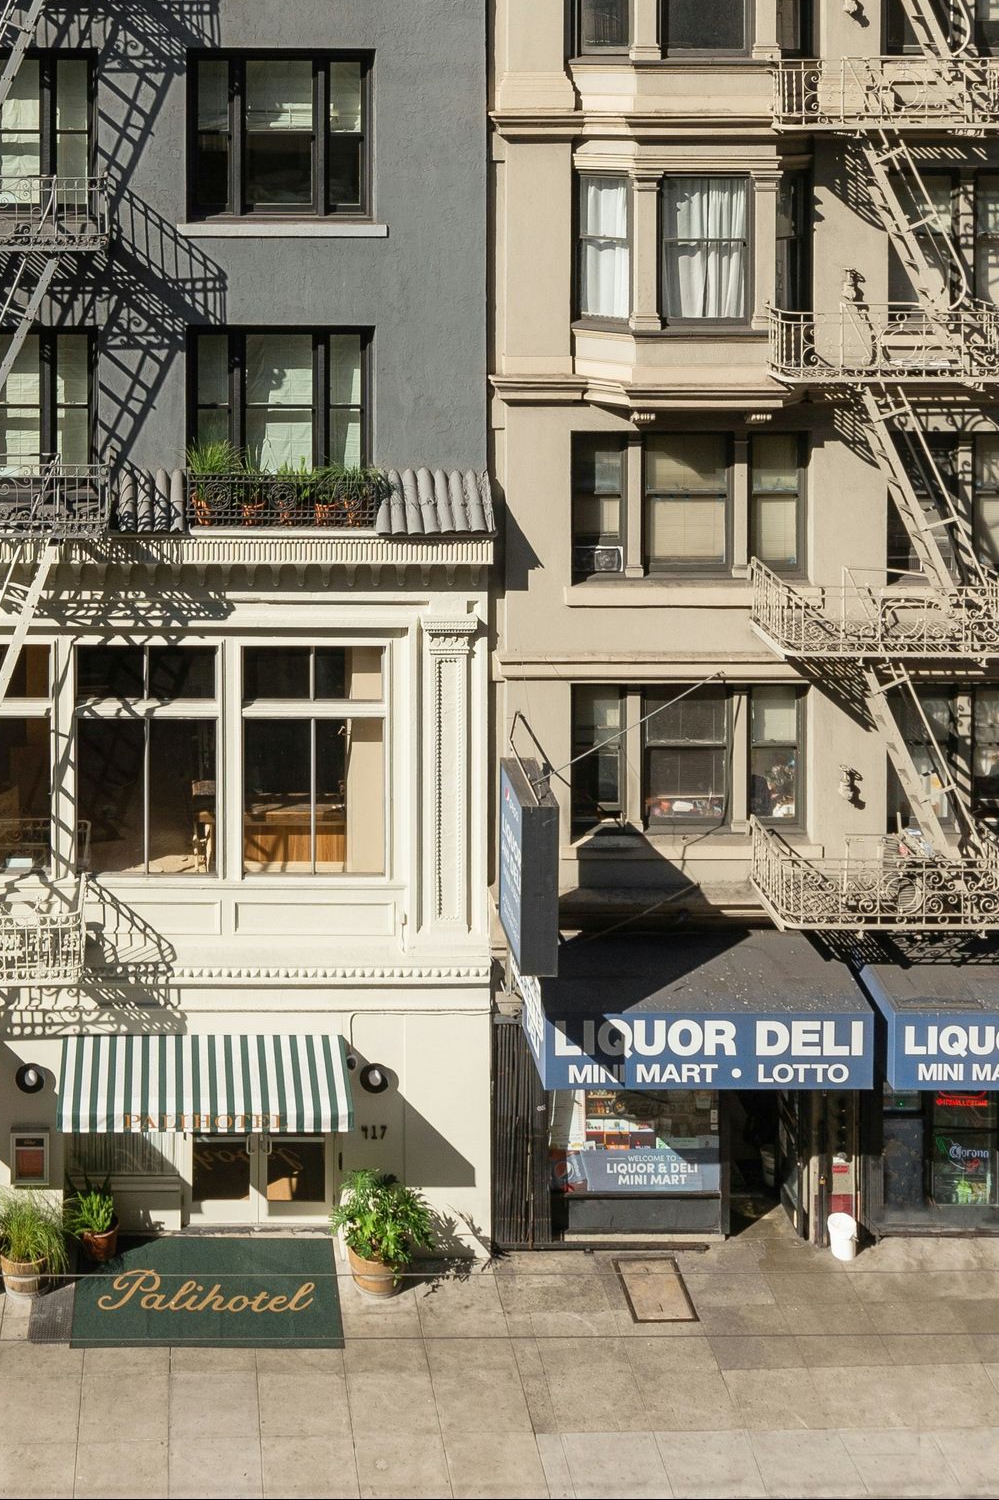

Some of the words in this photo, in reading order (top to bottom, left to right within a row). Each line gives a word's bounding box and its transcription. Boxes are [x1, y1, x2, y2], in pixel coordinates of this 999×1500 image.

[554, 1019, 736, 1059] LIQUOR
[755, 1020, 864, 1056] DELI
[904, 1025, 999, 1058] LIQU
[568, 1064, 625, 1083] MINI
[636, 1064, 718, 1083] MART
[758, 1063, 849, 1083] LOTTO
[918, 1063, 964, 1081] MINI
[123, 1113, 289, 1129] PALIHOTEL
[360, 1124, 388, 1140] 417
[950, 1143, 989, 1159] Corona
[606, 1163, 655, 1174] LIQUOR
[658, 1163, 667, 1174] &
[670, 1163, 698, 1174] DELI
[618, 1174, 647, 1185] MINI
[650, 1174, 687, 1185] MART
[97, 1269, 315, 1313] Palihotel
